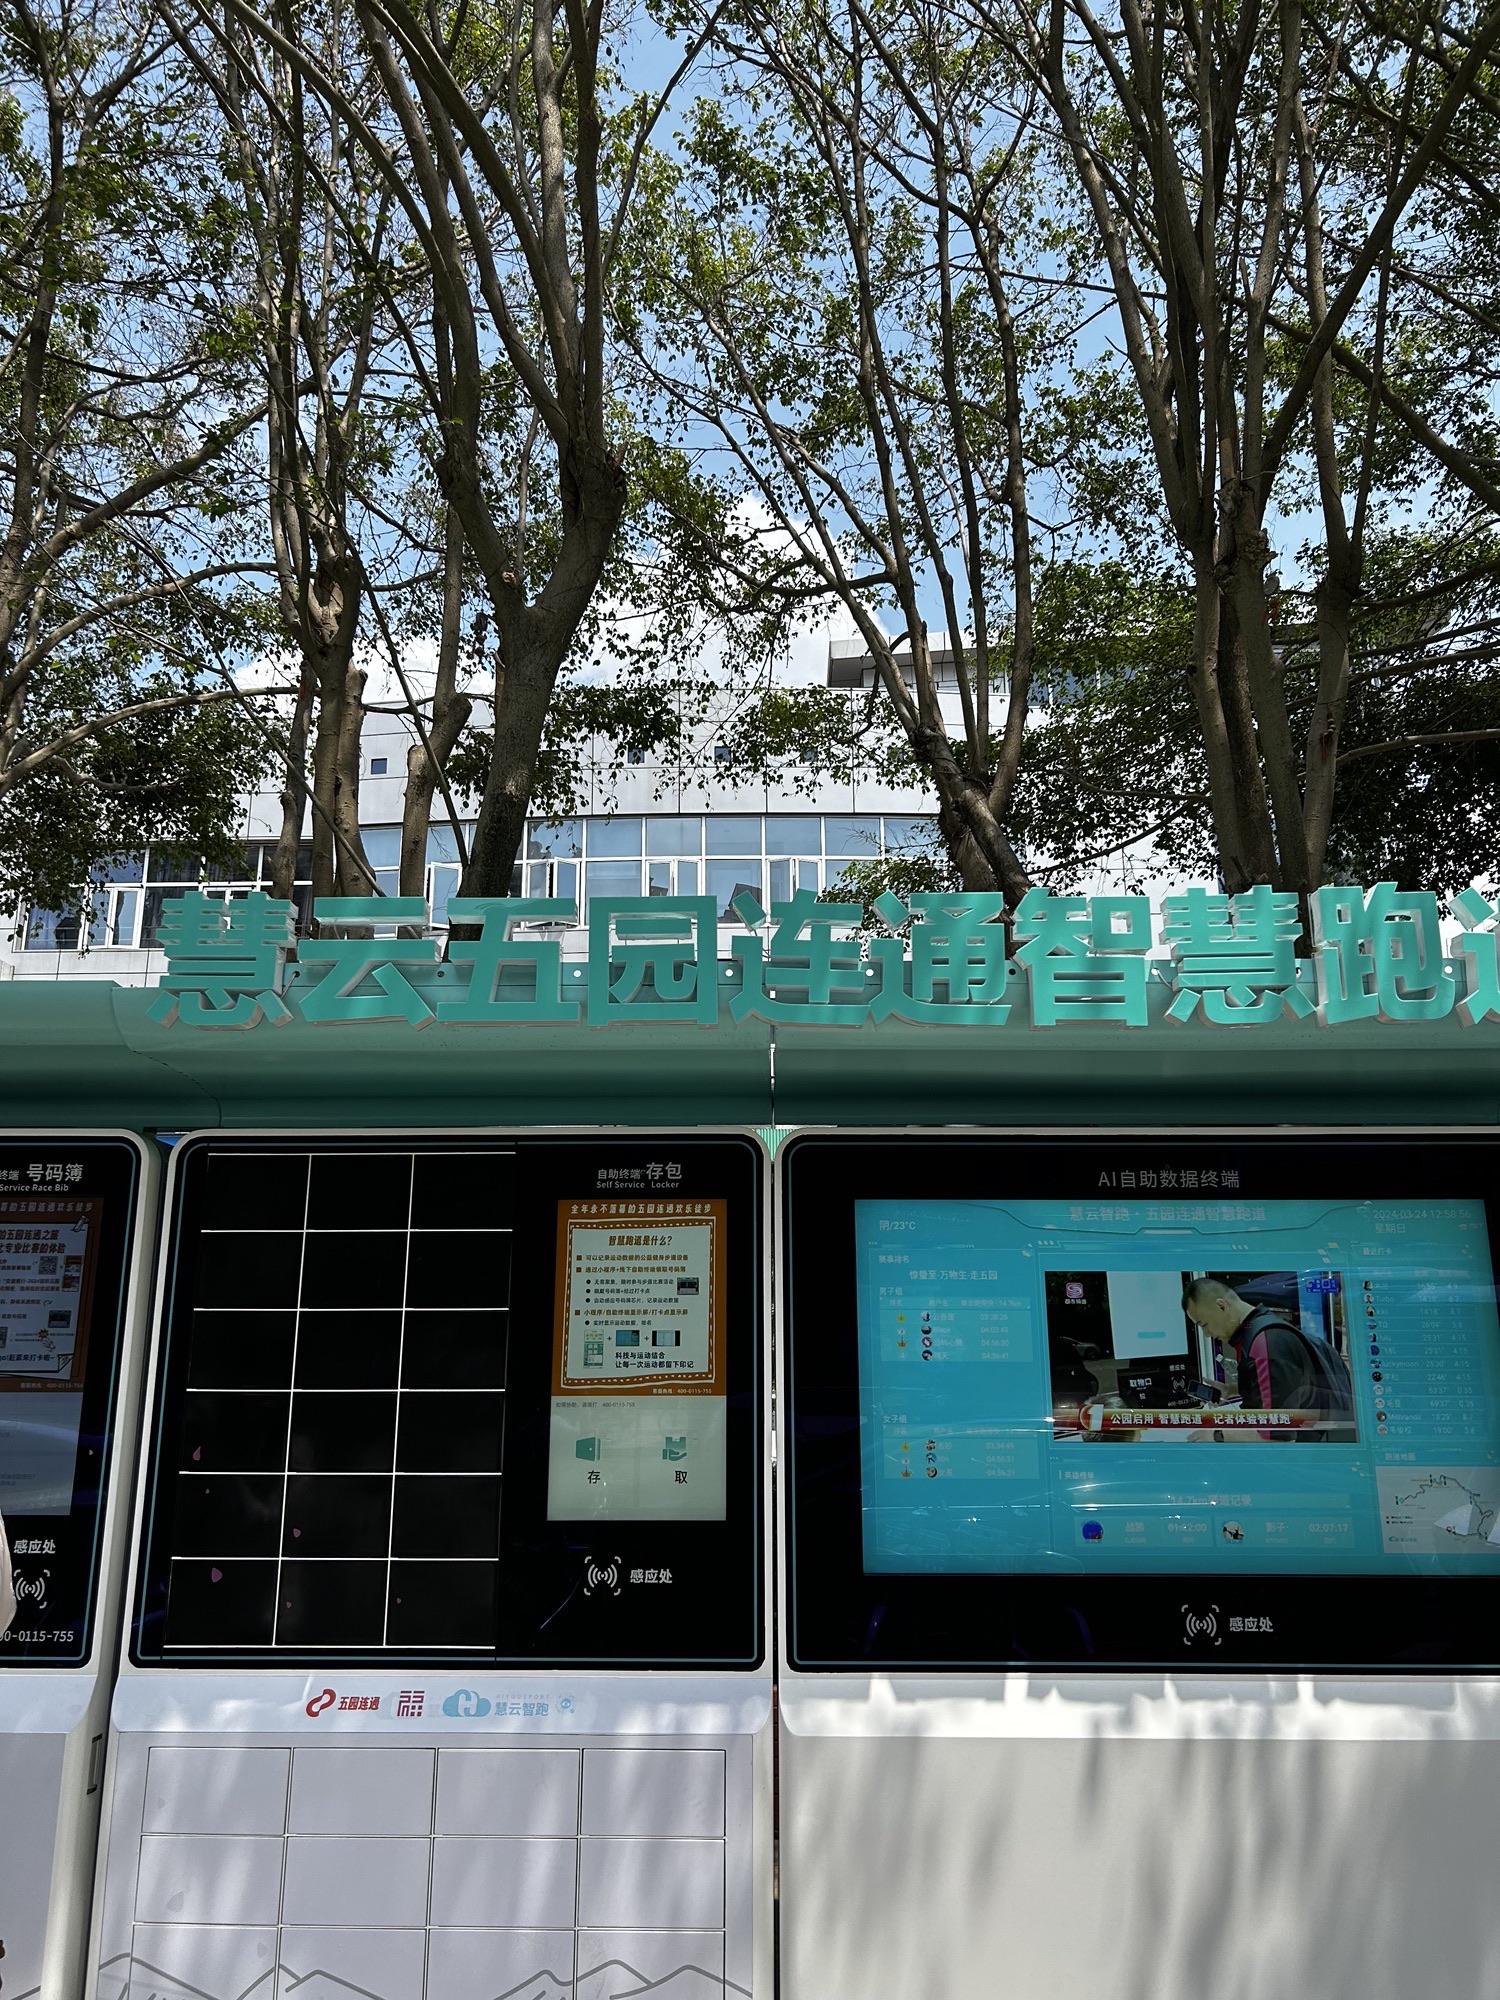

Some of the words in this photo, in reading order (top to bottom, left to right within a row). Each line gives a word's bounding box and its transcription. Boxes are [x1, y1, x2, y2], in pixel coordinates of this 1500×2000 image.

[26, 1163, 84, 1182] 号码簿
[598, 1169, 641, 1179] 自助终端
[646, 1162, 682, 1180] 存包
[1098, 1170, 1240, 1188] AI自助数据终端
[571, 1203, 711, 1214] 全年永不落幕的五园连通欢乐徒步
[1375, 1223, 1406, 1233] 星期日
[608, 1236, 672, 1246] 智慧跑道是什么?
[879, 1286, 903, 1296] 男子组
[615, 1352, 665, 1360] 科技与运动结合
[615, 1361, 694, 1369] 让每一次运动都留下印记
[883, 1414, 907, 1424] 女子组
[587, 1470, 601, 1484] 存
[675, 1470, 688, 1484] 取
[13, 1538, 57, 1555] 感应处
[629, 1568, 673, 1584] 感应处
[1229, 1617, 1274, 1632] 感应处
[338, 1696, 381, 1712] 五园连通
[494, 1702, 549, 1716] 慧云智跑
